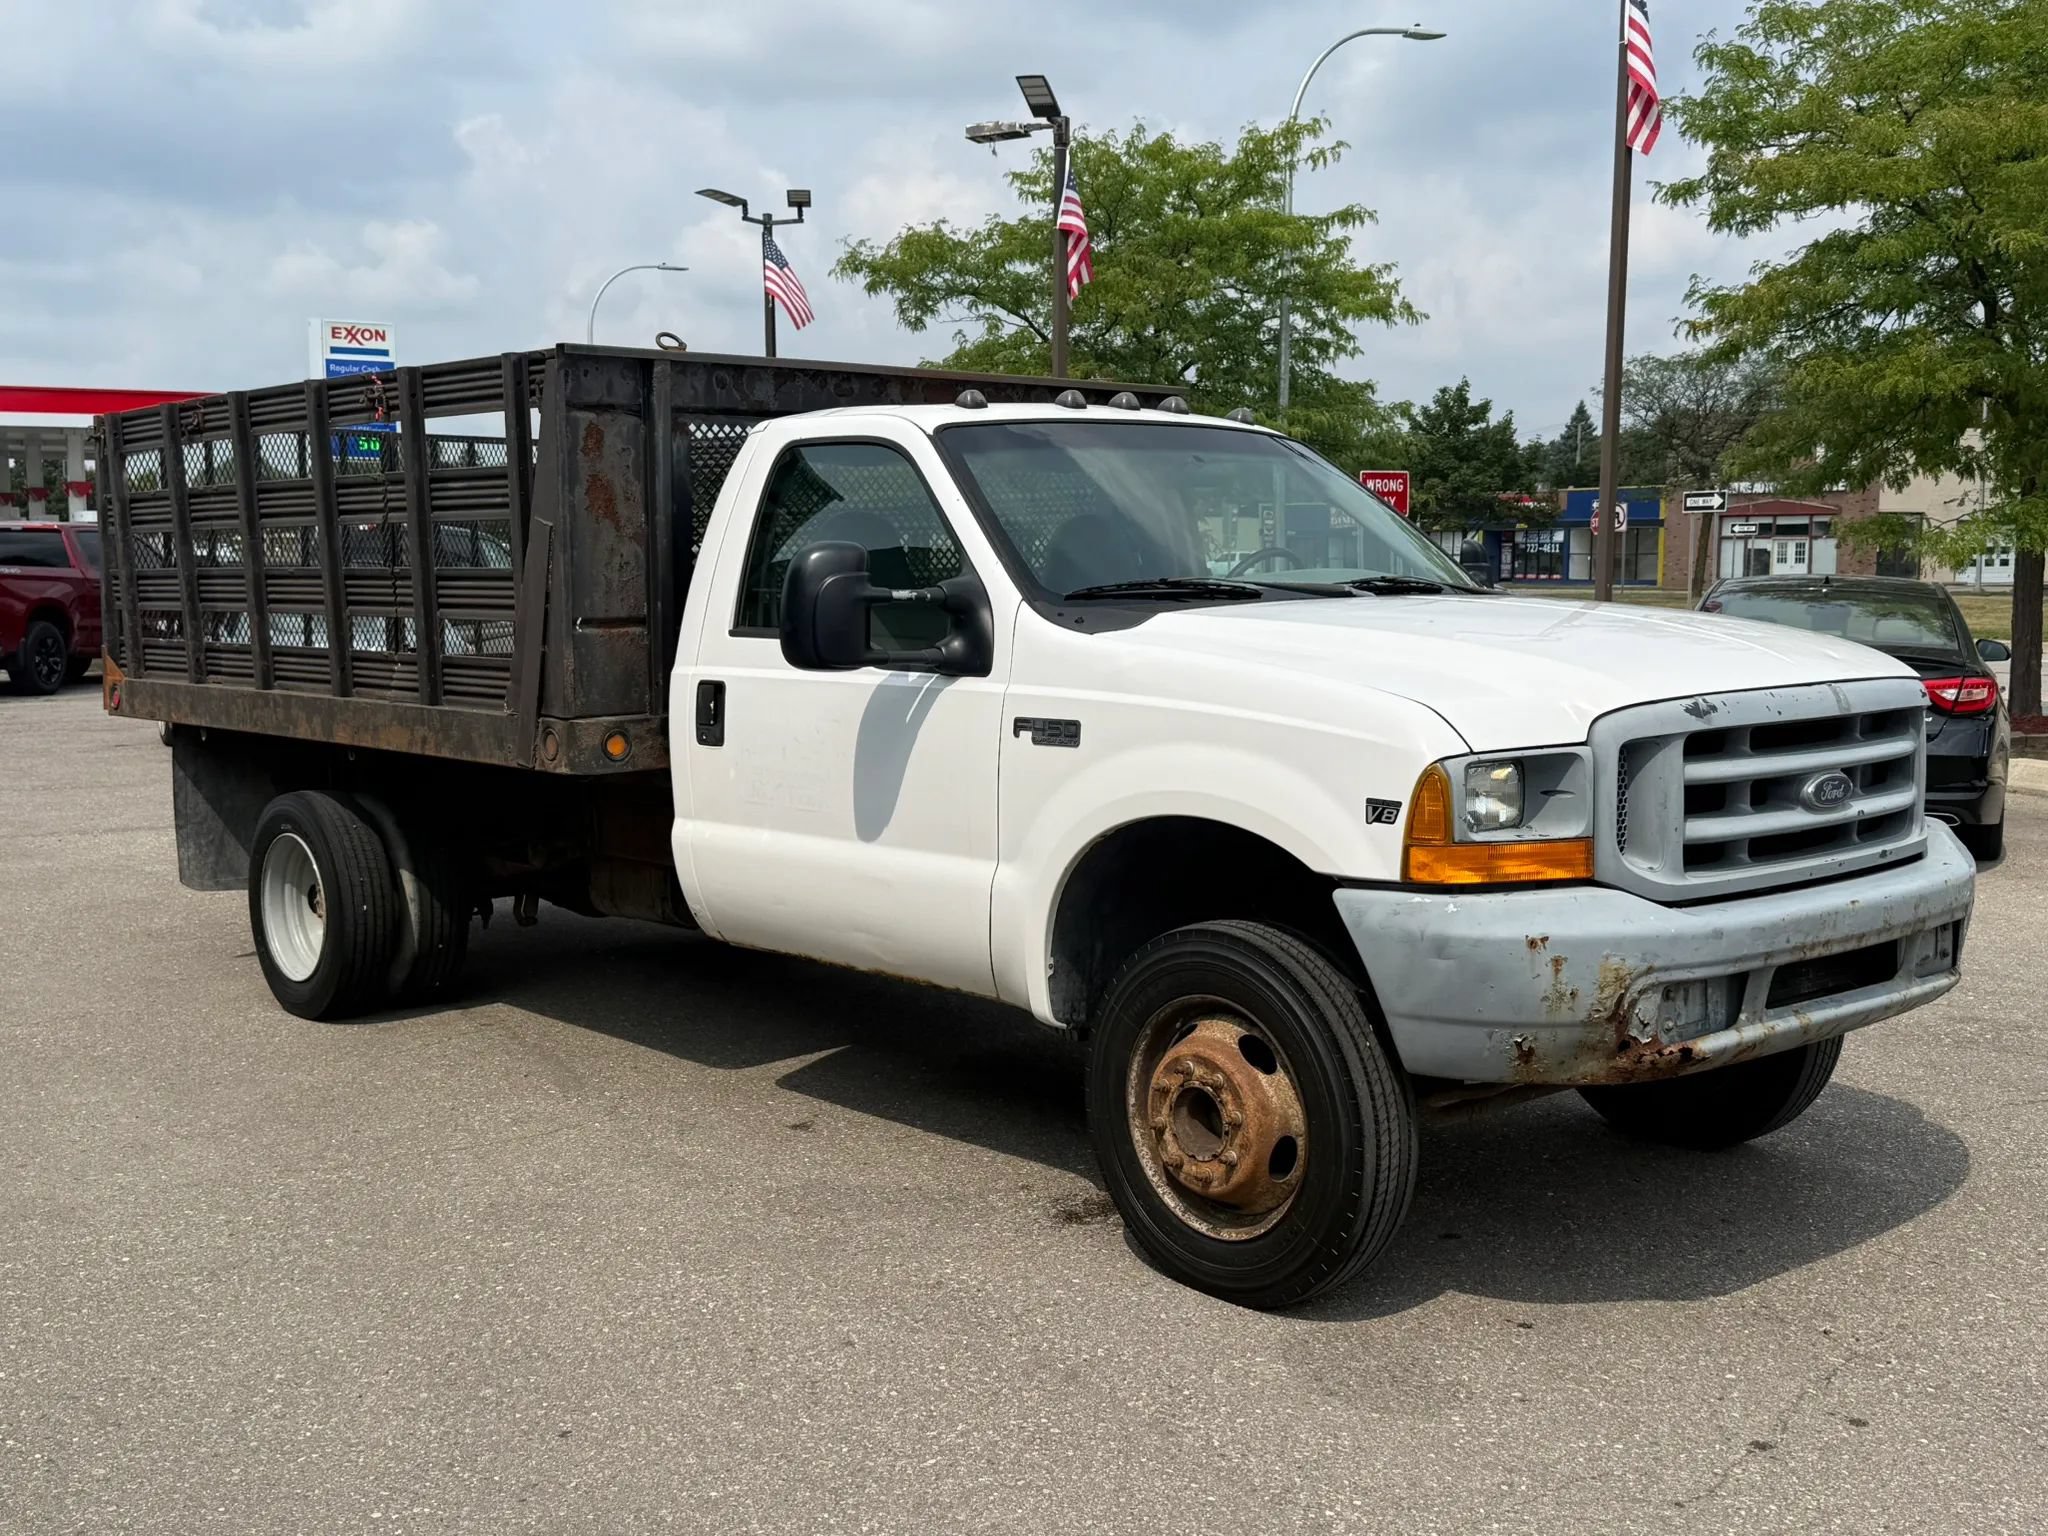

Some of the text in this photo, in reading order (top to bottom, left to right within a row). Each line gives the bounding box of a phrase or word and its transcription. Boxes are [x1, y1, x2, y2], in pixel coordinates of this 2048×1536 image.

[331, 325, 386, 346] EXXON
[329, 364, 359, 373] Regular
[1366, 479, 1404, 492] WRONG
[1820, 780, 1845, 801] Ford
[1366, 805, 1399, 824] V8
